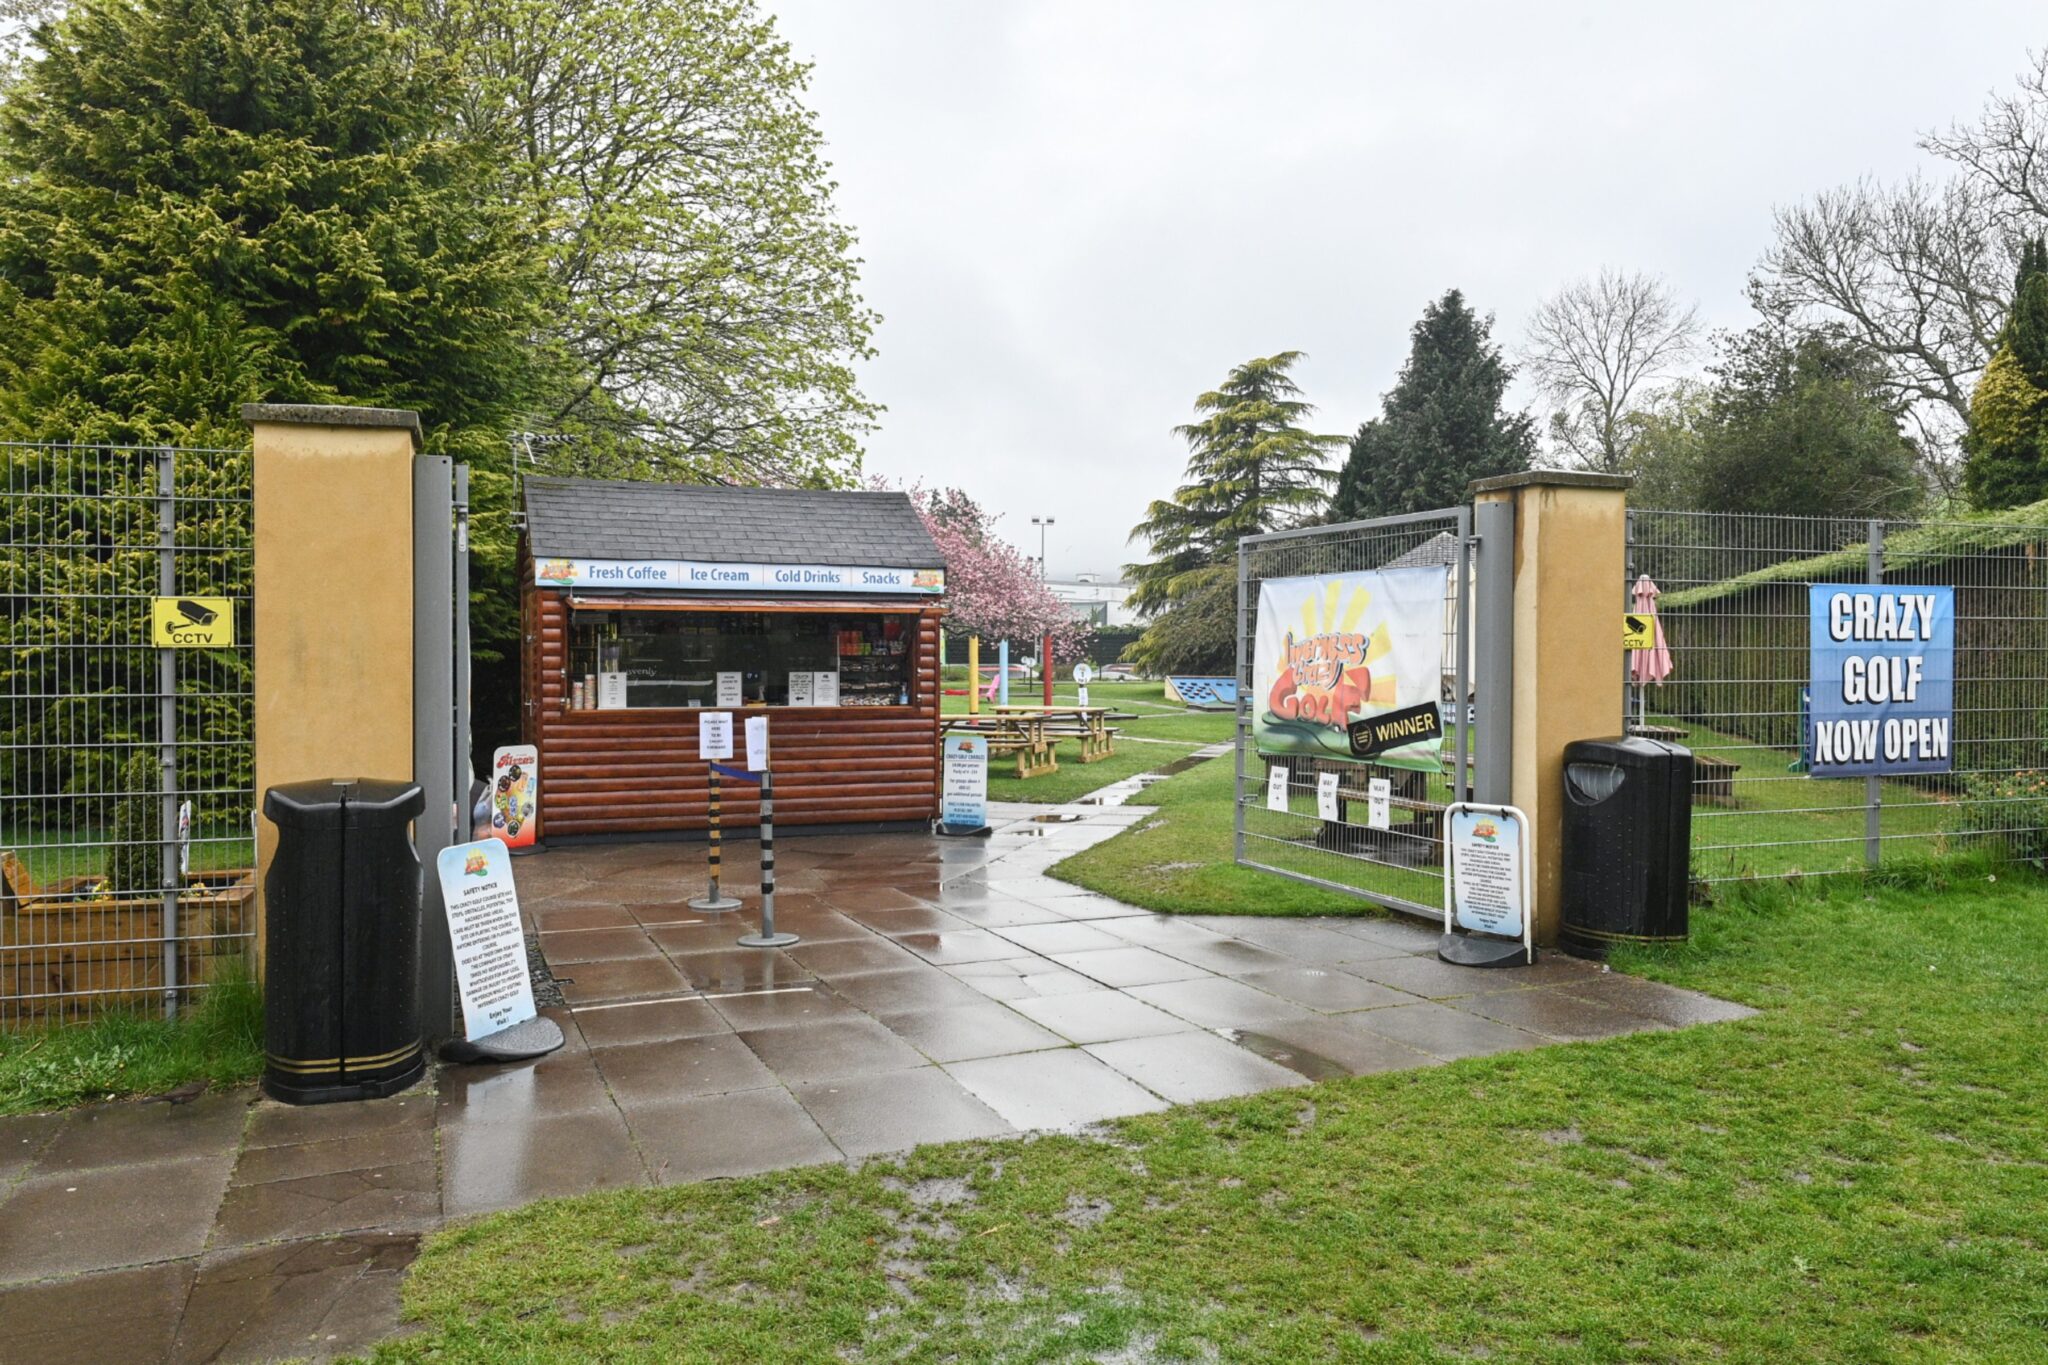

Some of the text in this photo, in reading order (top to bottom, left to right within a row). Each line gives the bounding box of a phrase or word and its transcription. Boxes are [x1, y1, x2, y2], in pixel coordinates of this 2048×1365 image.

[589, 566, 624, 579] Fresh
[627, 566, 667, 580] Coffee
[690, 568, 749, 582] Ice Cream
[776, 570, 840, 583] Cold Drinks
[863, 572, 900, 584] Snacks
[1830, 593, 1935, 642] CRAZY
[173, 634, 213, 643] CCTV
[1843, 656, 1923, 704] GOLF
[1376, 712, 1435, 742] WINNER
[1815, 719, 1880, 764] NOW
[1884, 718, 1948, 762] OPEN
